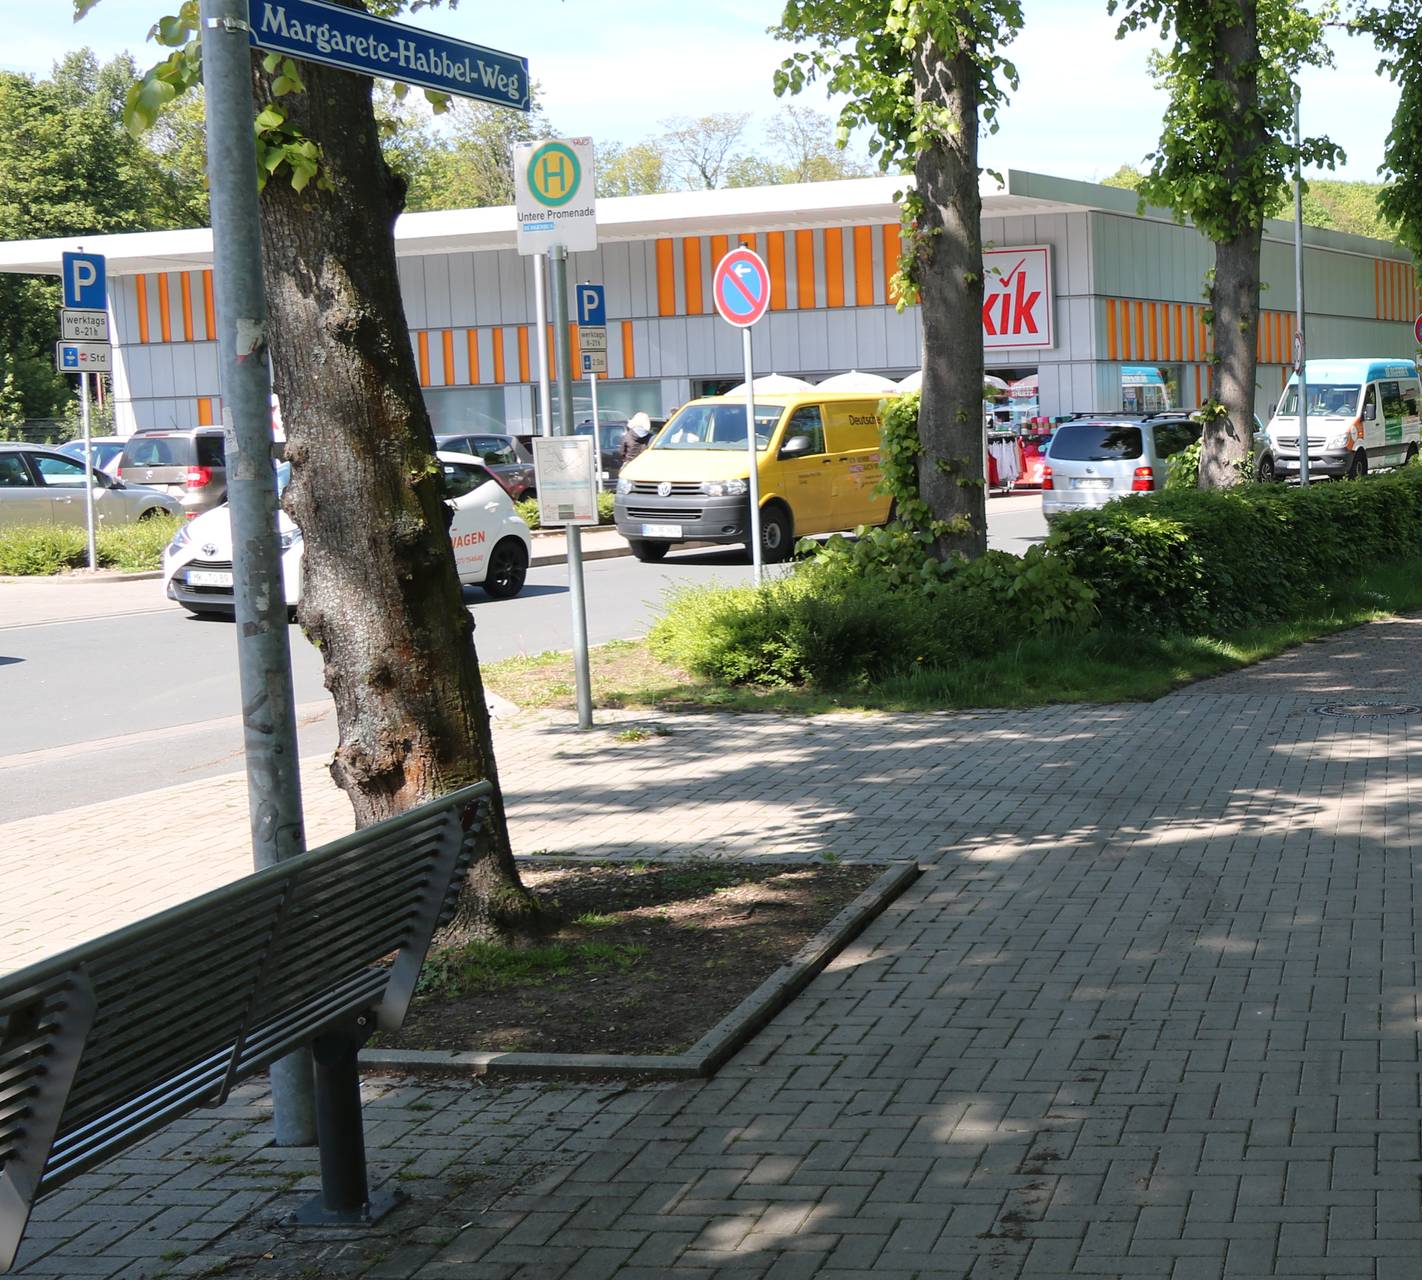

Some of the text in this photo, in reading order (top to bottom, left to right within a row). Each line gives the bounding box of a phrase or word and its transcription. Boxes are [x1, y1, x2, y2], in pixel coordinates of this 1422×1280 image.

[261, 3, 519, 99] Margarete-Habbel-Weg
[542, 156, 565, 193] H
[518, 206, 595, 222] Untere Promenade
[73, 260, 96, 302] P
[66, 315, 105, 326] werktags
[583, 290, 599, 321] P
[75, 327, 98, 337] 8-21h
